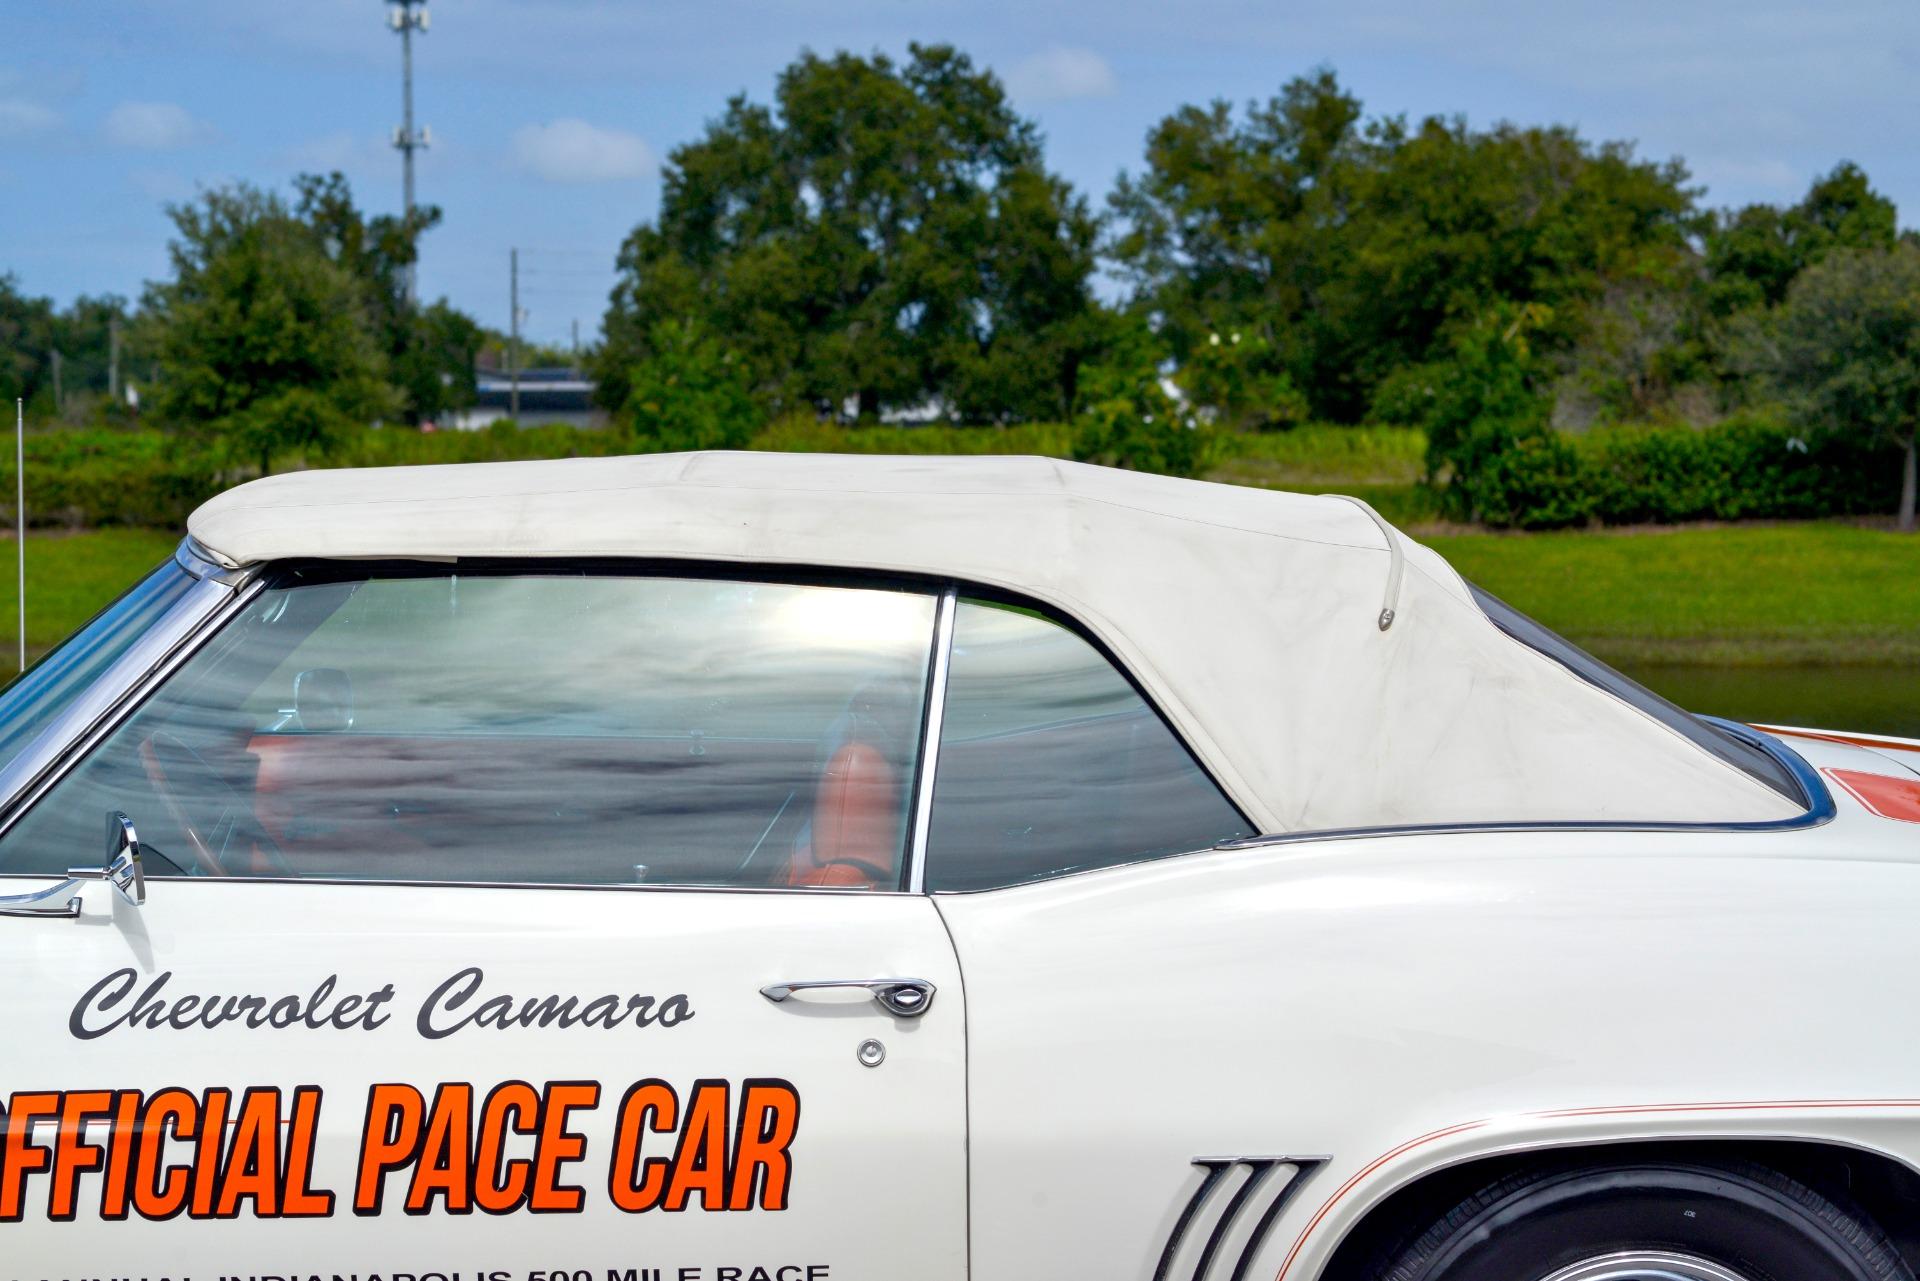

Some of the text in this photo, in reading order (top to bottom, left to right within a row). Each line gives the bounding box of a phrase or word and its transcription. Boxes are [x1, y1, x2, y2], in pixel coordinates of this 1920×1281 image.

[69, 967, 696, 1040] Chevrolet Camaro
[0, 1077, 801, 1222] FFICIAL PACE CAR
[716, 1264, 831, 1281] RACE
